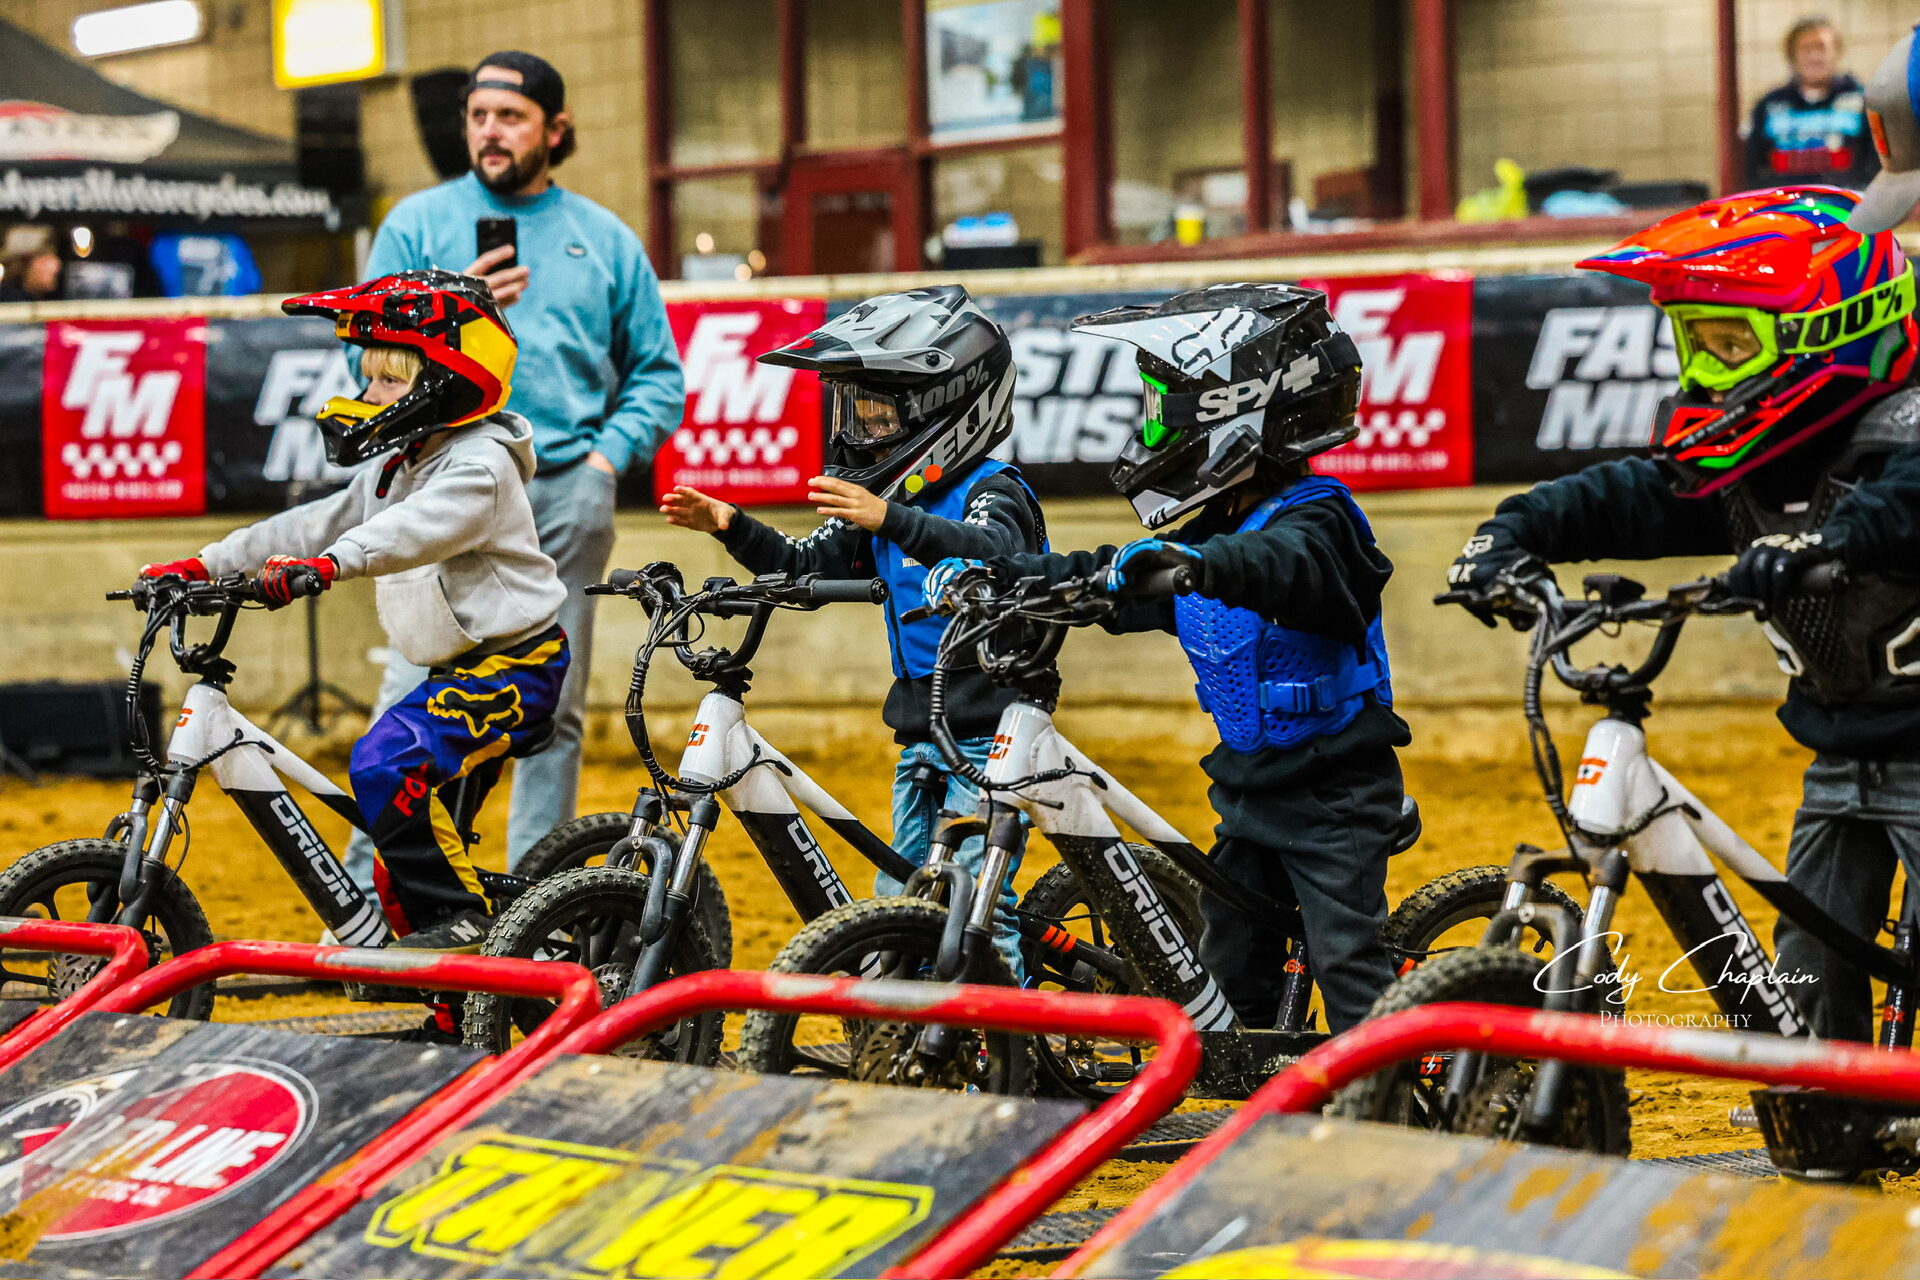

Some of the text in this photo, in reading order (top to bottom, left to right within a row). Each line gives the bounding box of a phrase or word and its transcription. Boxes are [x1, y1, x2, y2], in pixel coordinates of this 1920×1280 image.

[904, 359, 989, 421] 100%
[1536, 379, 1676, 449] MI
[1447, 563, 1477, 583] OX
[270, 794, 359, 908] ORION
[787, 816, 854, 910] ORIO
[1103, 841, 1204, 983] ORION
[1702, 878, 1805, 1038] ORION
[130, 1124, 287, 1189] LINE
[384, 1144, 912, 1280] TANNER
